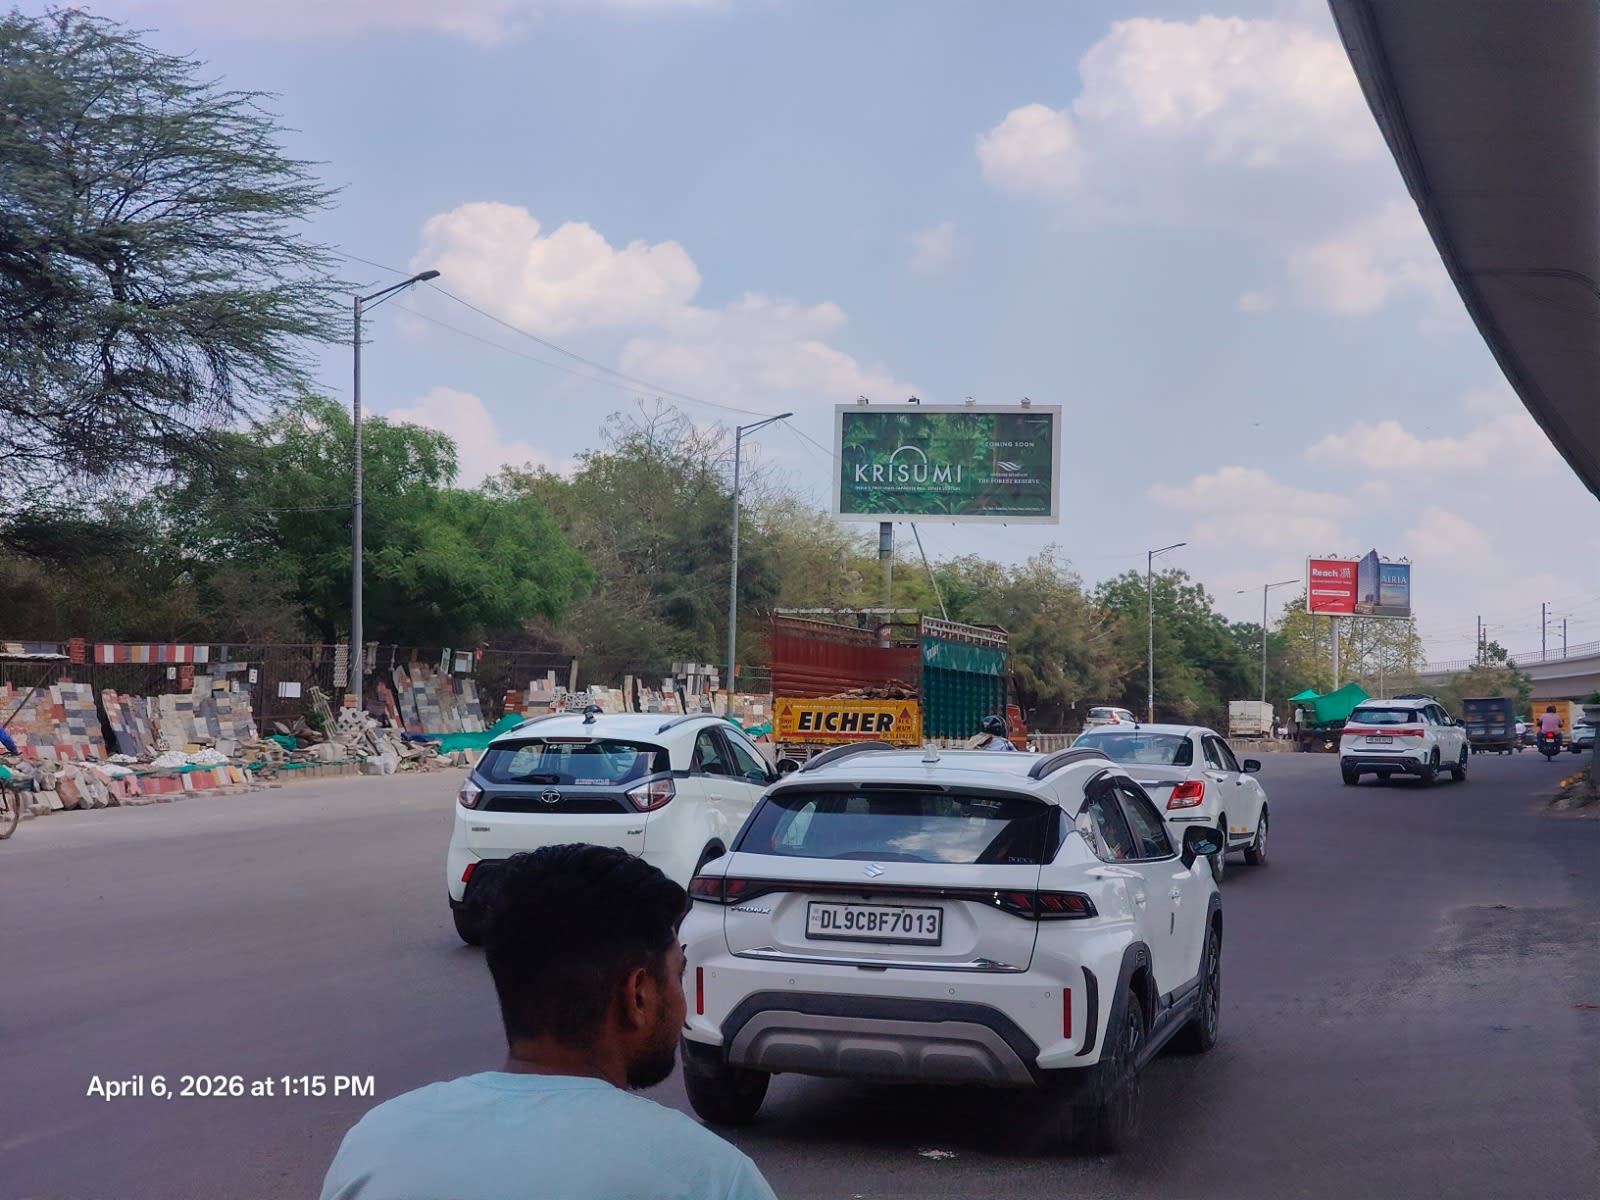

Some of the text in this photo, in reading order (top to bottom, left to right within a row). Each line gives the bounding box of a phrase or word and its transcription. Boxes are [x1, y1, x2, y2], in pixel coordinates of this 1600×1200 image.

[855, 463, 962, 483] KRISUMI
[1312, 568, 1338, 577] Reach
[797, 711, 895, 733] EICHER
[820, 909, 937, 934] DL9CBF7013
